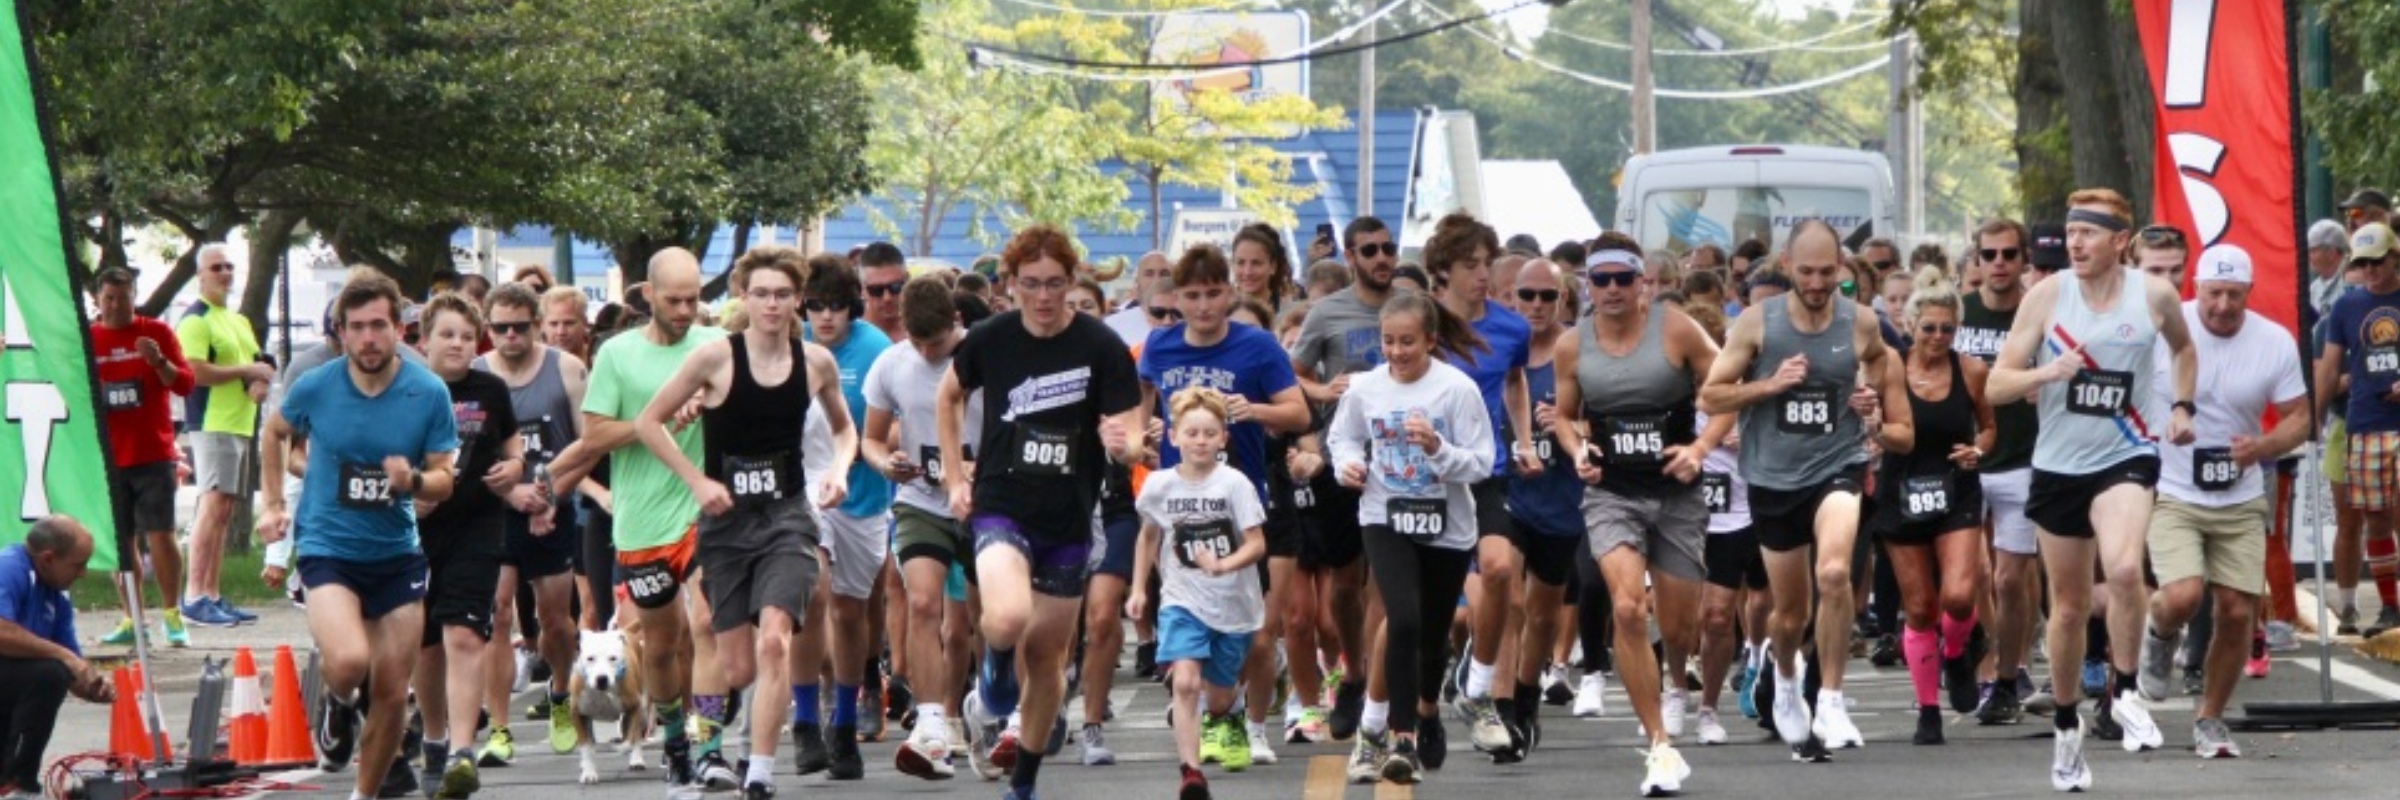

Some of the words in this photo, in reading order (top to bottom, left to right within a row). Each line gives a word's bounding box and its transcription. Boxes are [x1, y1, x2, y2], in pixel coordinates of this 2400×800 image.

[1183, 220, 1227, 233] Burgers
[1774, 216, 1820, 228] FLE
[2075, 382, 2126, 410] 1047
[1786, 401, 1829, 424] 883
[1023, 440, 1069, 467] 909
[1611, 432, 1662, 455] 1045
[348, 476, 391, 501] 932
[1908, 490, 1946, 514] 893
[1391, 512, 1443, 534] 1020
[628, 568, 673, 600] 1033
